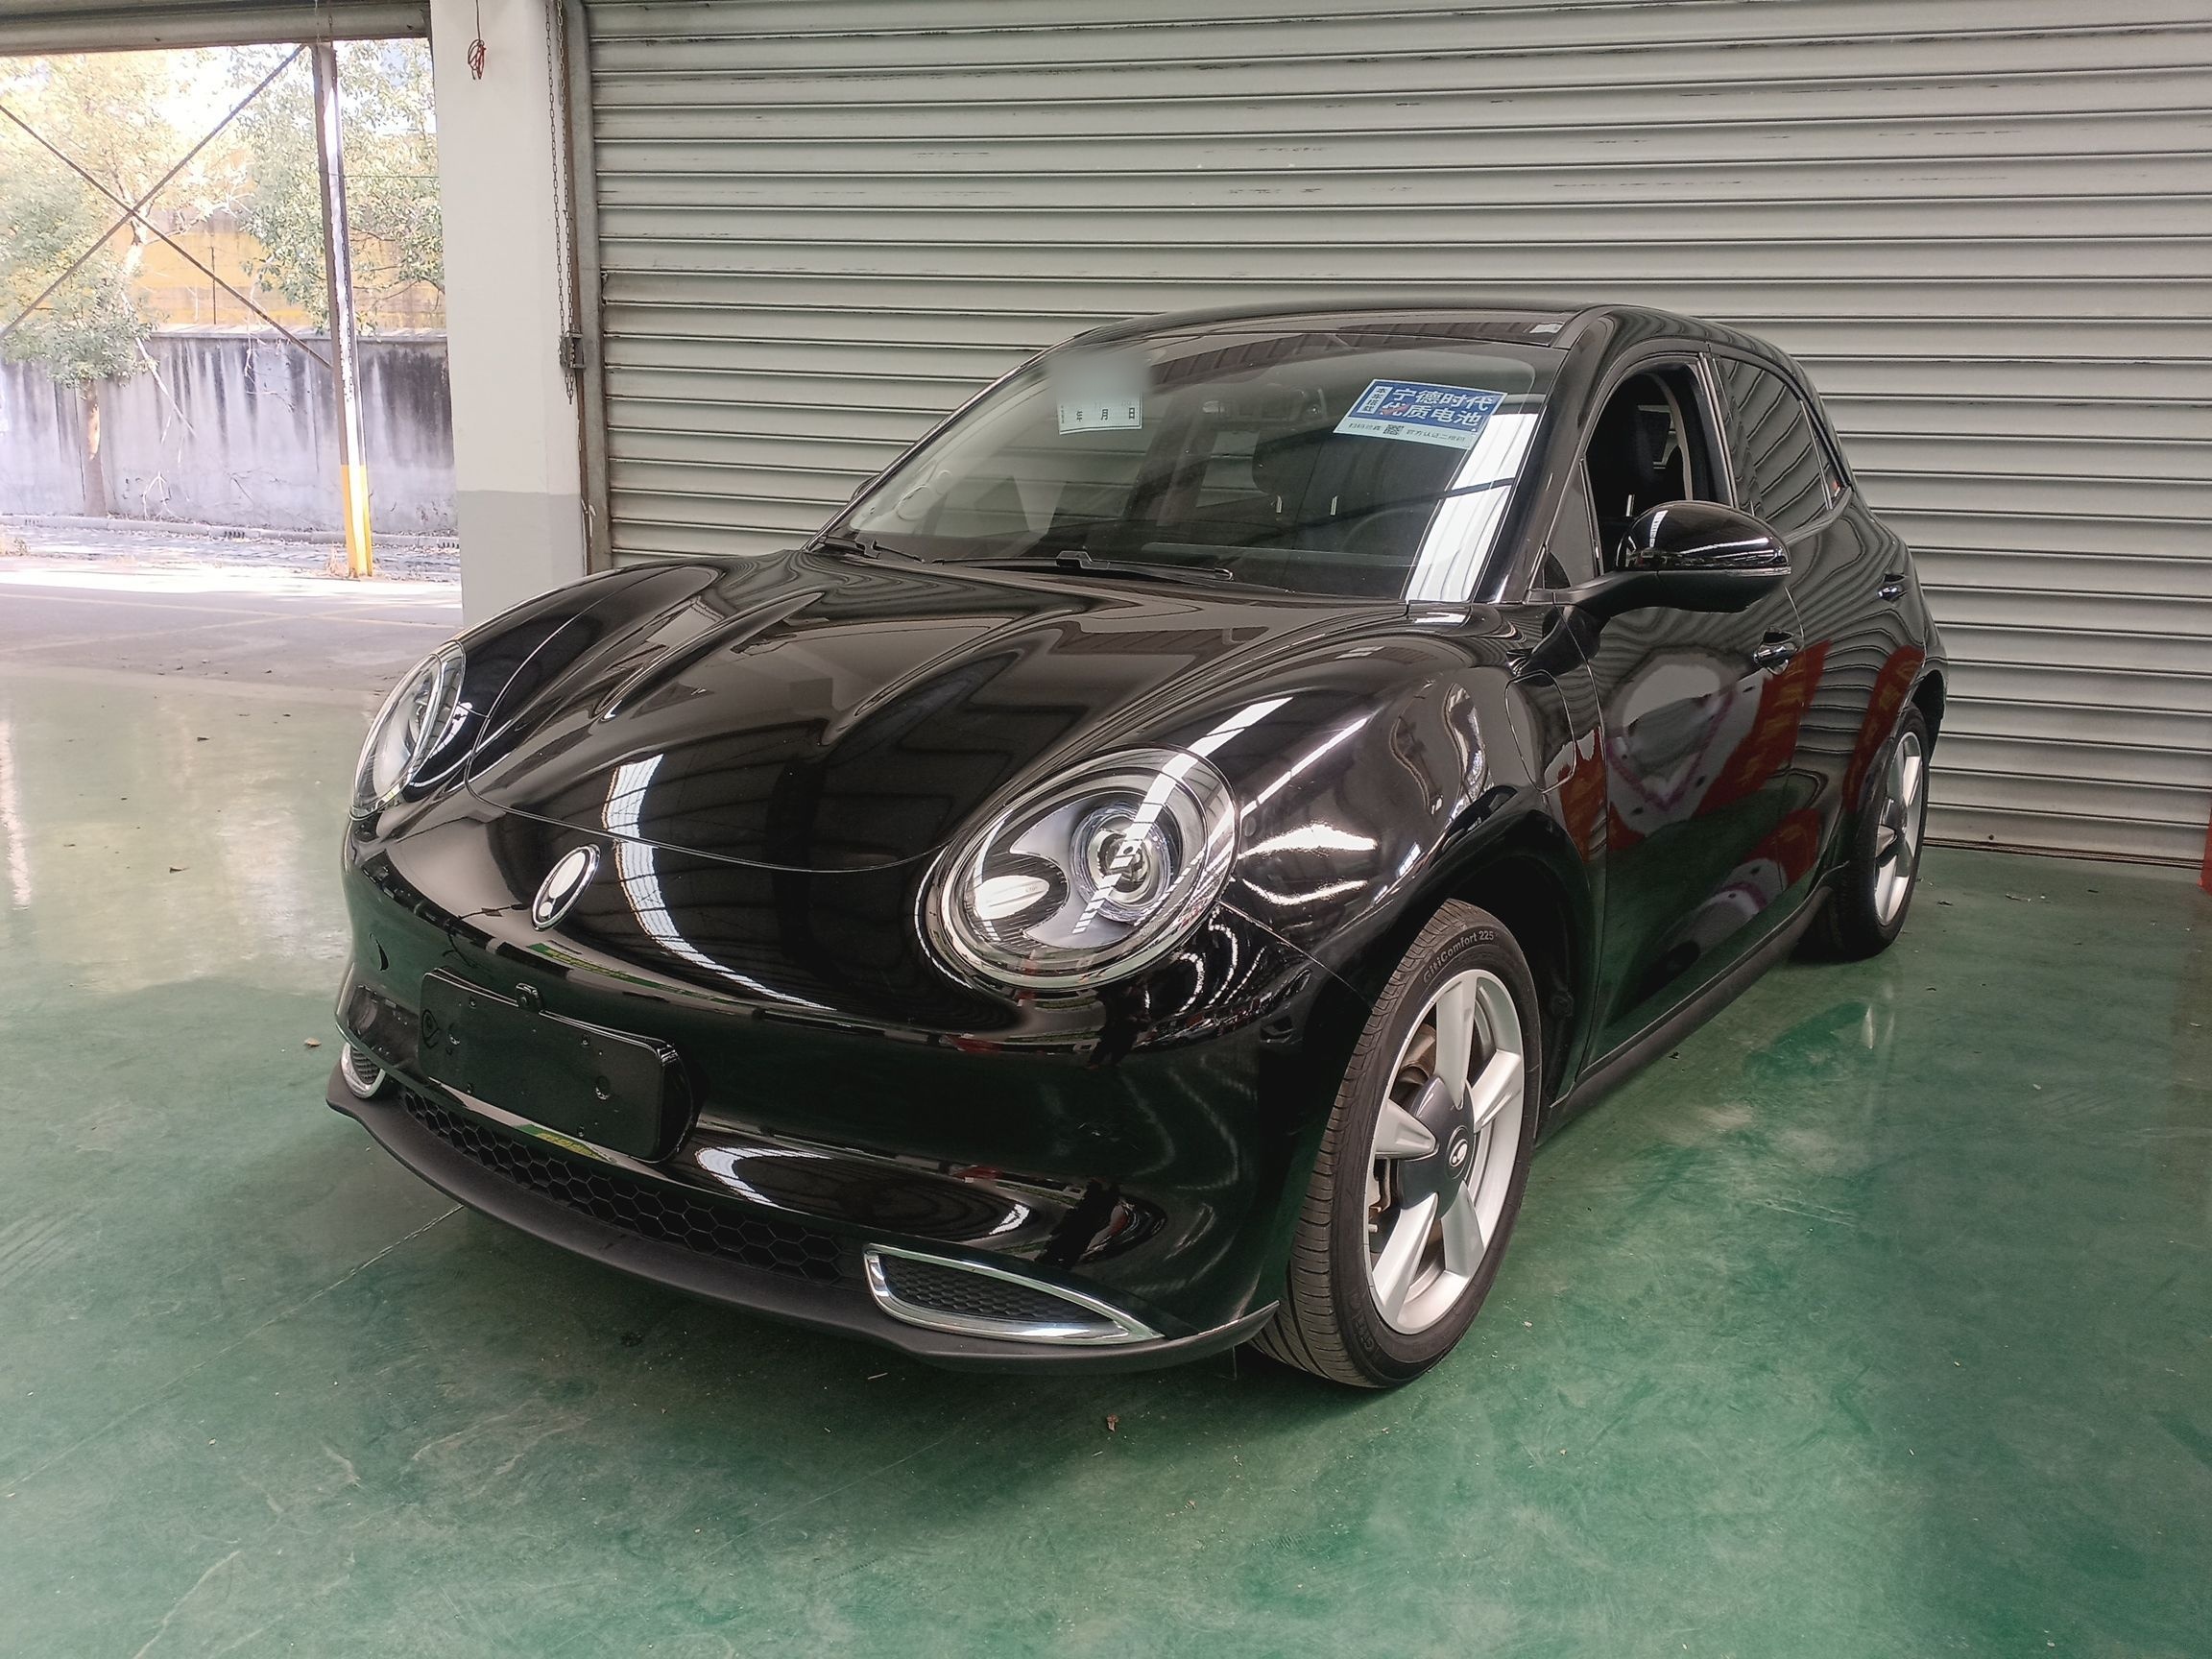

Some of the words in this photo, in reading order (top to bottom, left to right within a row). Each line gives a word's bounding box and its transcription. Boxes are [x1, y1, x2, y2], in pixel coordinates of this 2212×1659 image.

[1392, 388, 1493, 411] 宁德时代
[1100, 408, 1109, 421] 月
[1128, 407, 1135, 420] 日
